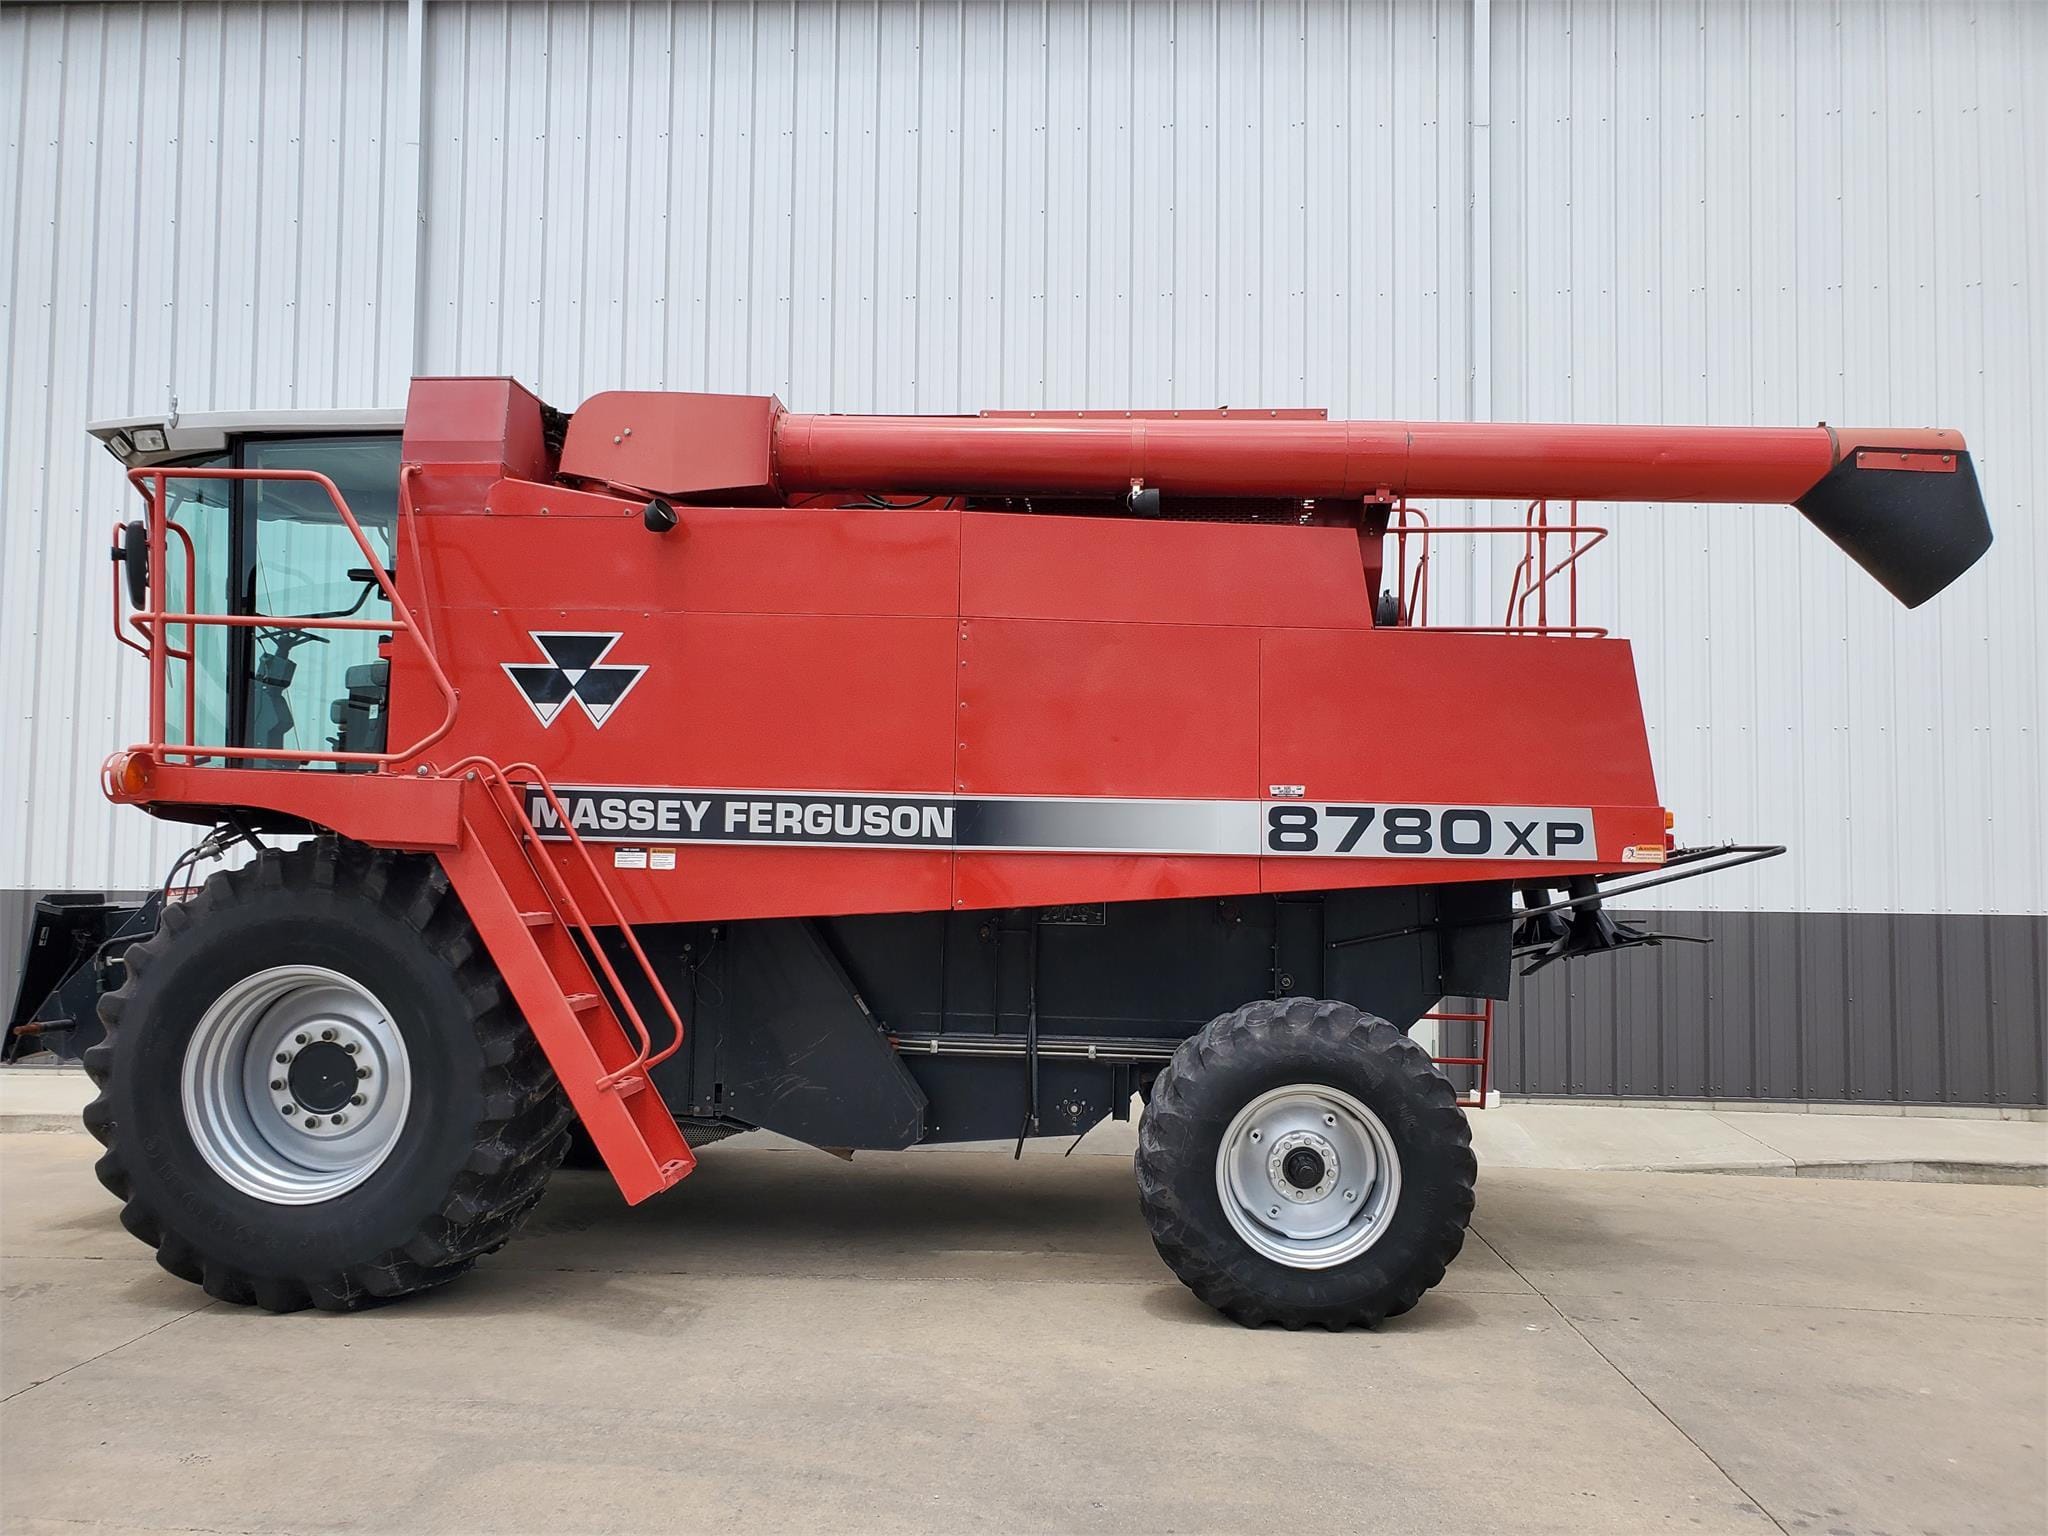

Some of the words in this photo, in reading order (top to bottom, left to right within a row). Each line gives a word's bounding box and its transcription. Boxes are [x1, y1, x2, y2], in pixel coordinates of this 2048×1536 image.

[531, 797, 711, 832] MASSEY
[724, 801, 953, 838] FERGUSON
[1268, 805, 1492, 854] 8780
[1504, 821, 1584, 856] XP
